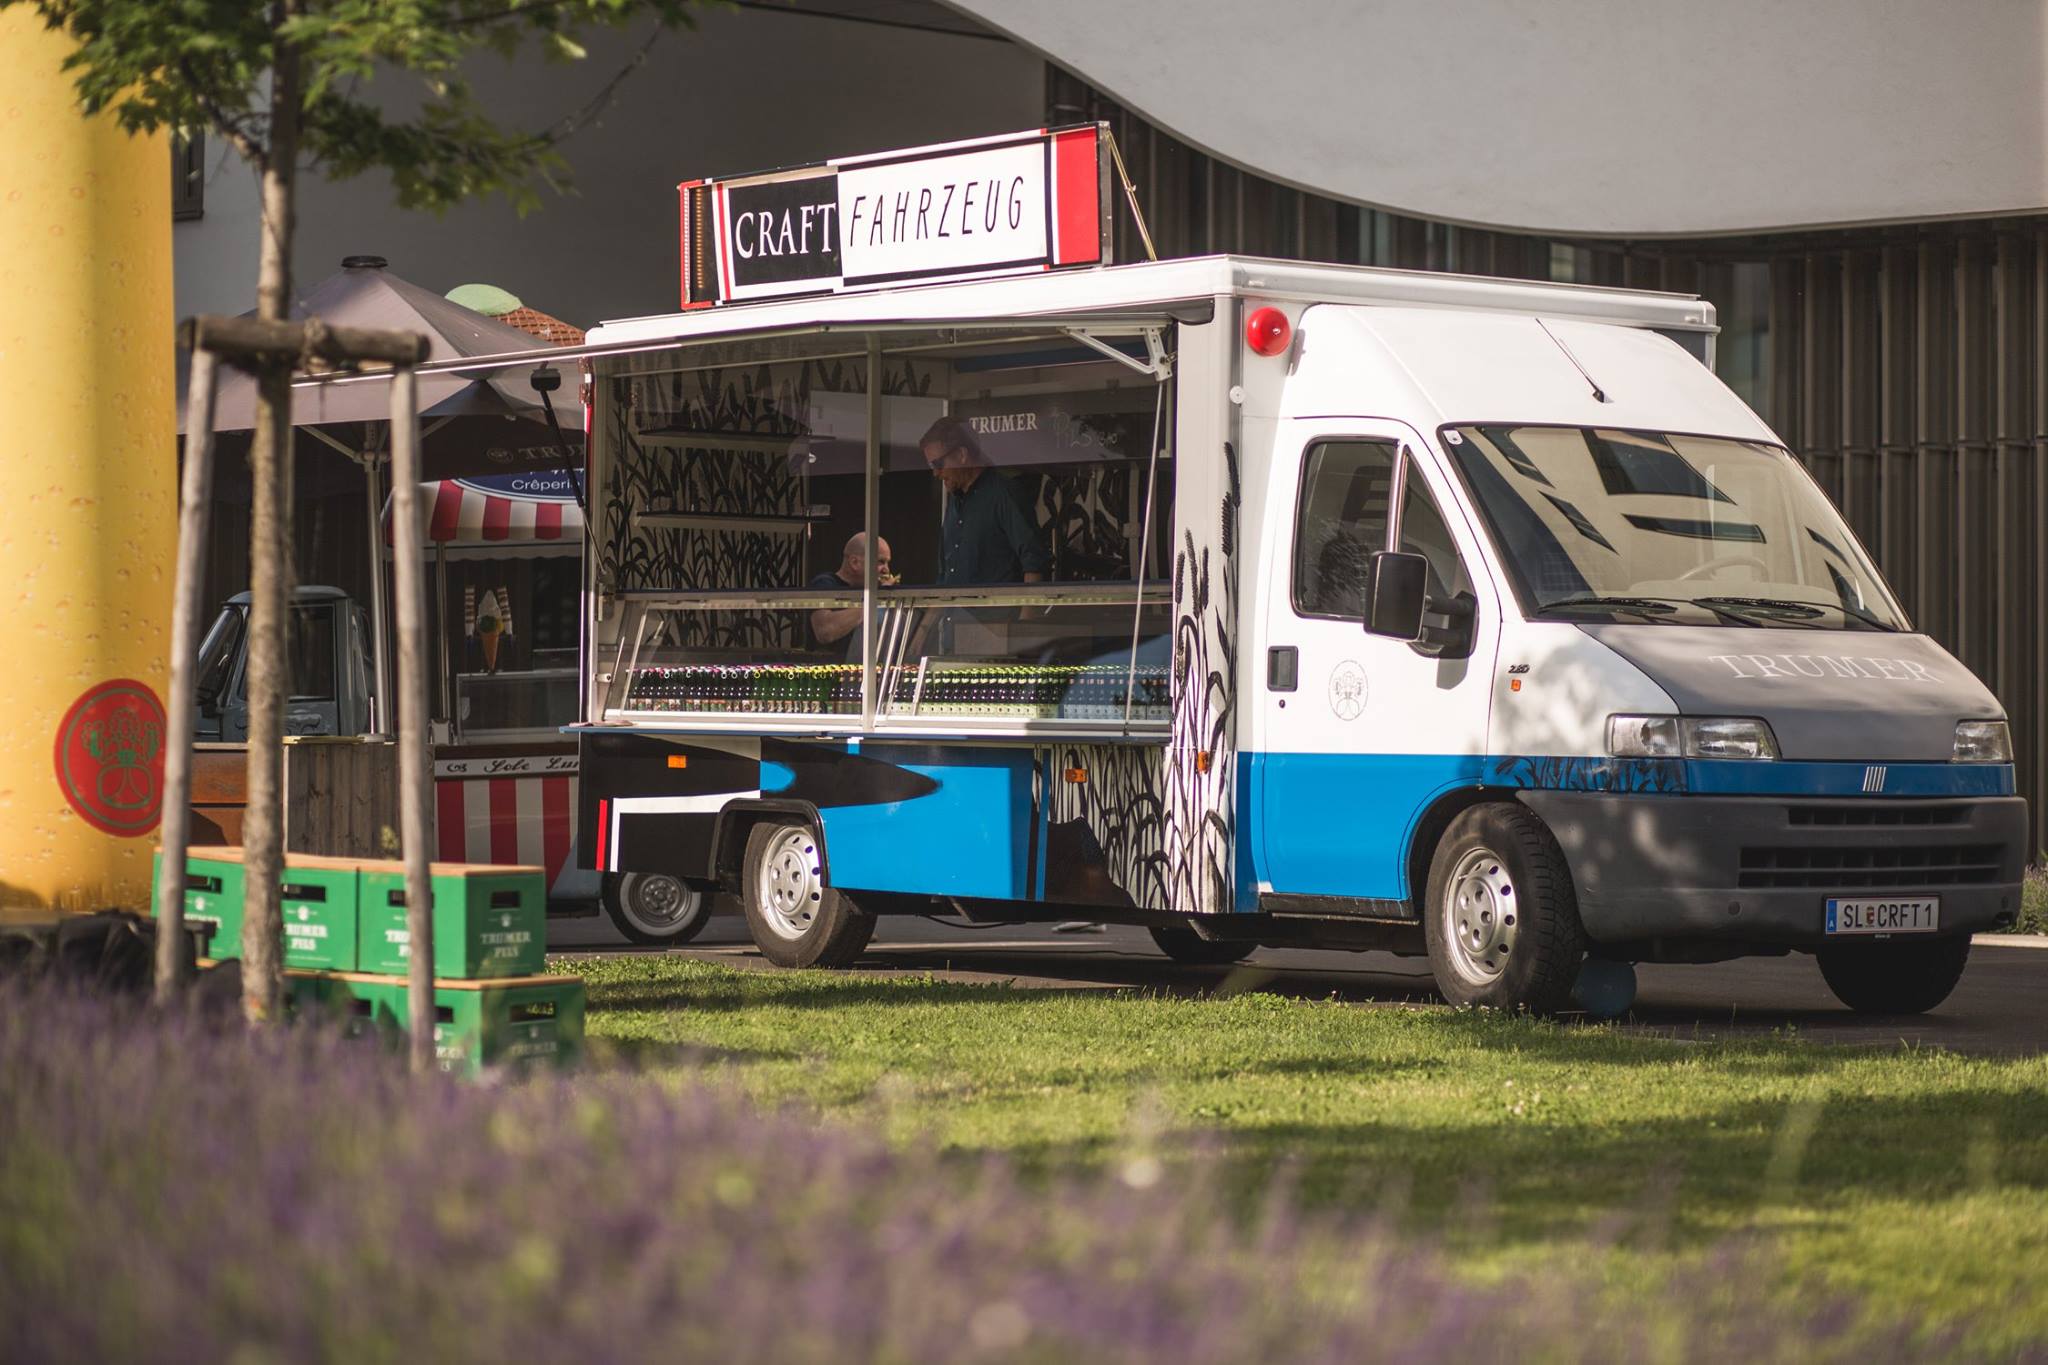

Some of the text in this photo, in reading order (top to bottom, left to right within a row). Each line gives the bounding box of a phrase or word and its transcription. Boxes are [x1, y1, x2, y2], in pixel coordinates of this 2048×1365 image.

[735, 176, 1024, 259] CRAFT FAHRZEUG
[968, 412, 1038, 434] TRUMER
[1707, 654, 1945, 684] TRUMER
[483, 758, 530, 773] Sole
[1843, 904, 1863, 928] SL
[480, 931, 532, 946] TRUMER
